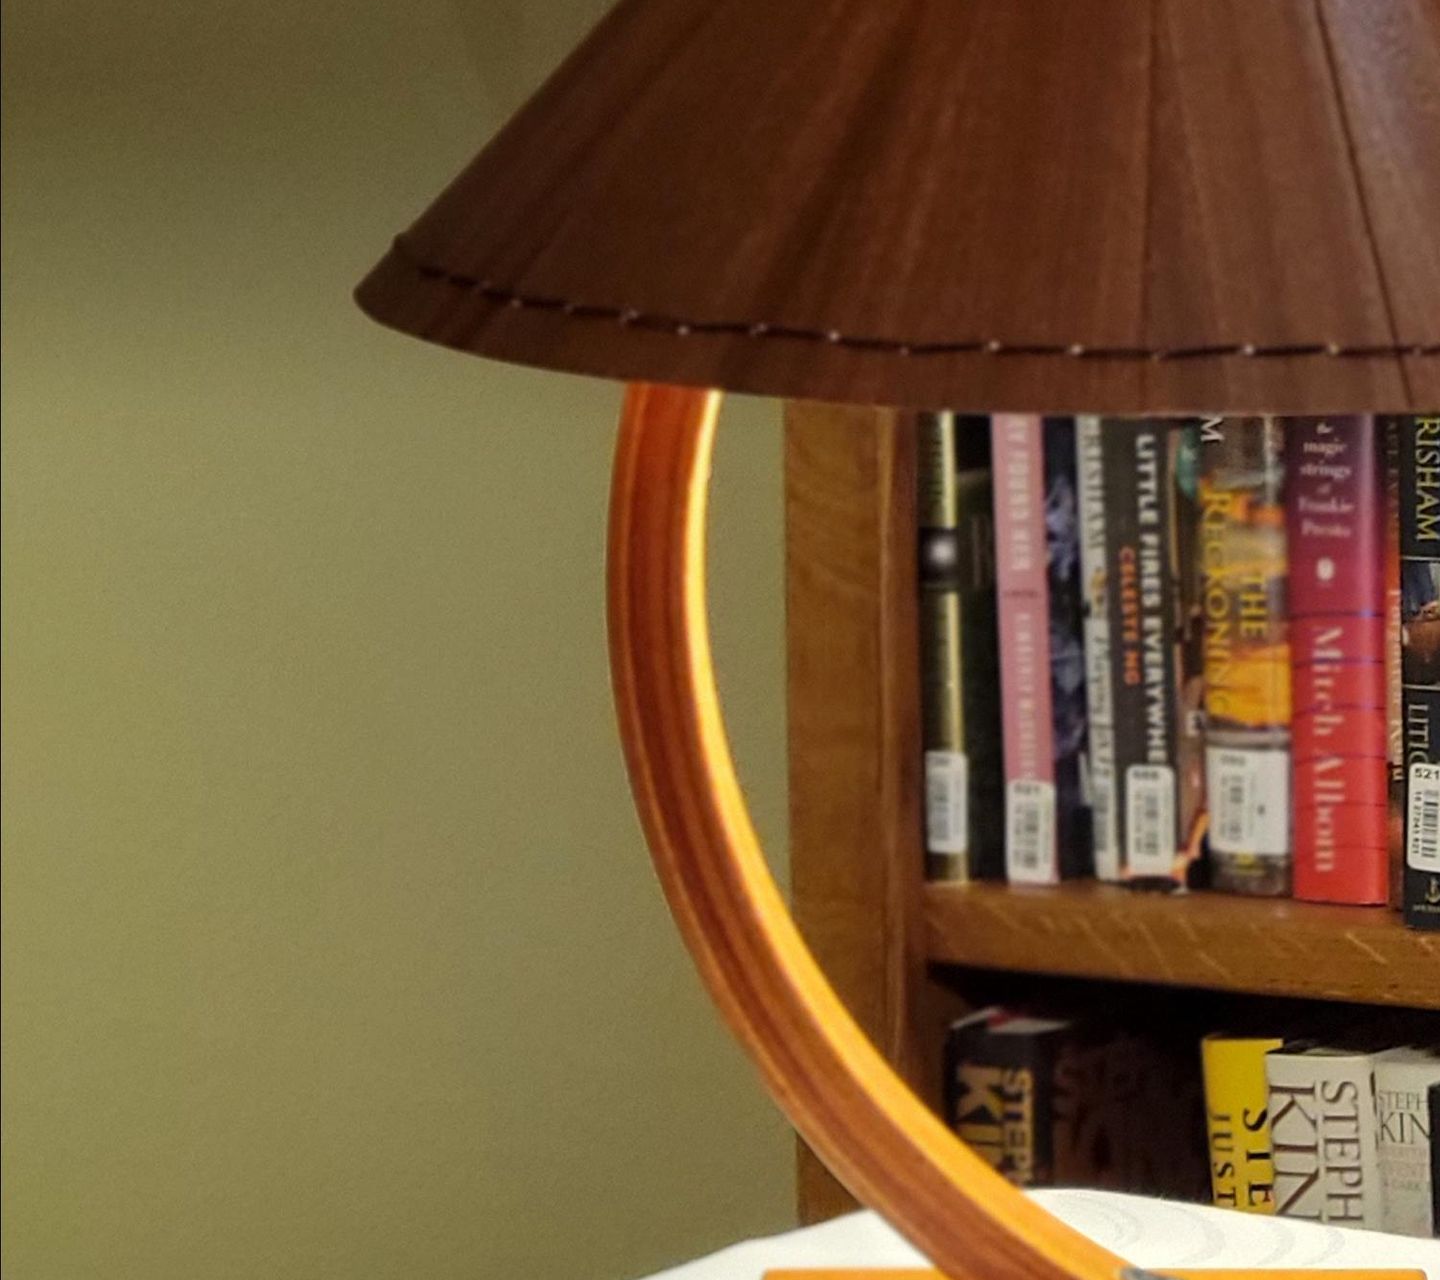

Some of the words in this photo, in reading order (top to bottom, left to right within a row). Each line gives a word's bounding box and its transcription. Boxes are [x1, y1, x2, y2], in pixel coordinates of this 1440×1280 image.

[1135, 433, 1156, 523] LITTLE
[1120, 546, 1139, 646] CELESTE
[1139, 531, 1160, 611] FIRES
[1202, 489, 1236, 718] RECKONING
[1240, 572, 1268, 639] THE
[1312, 625, 1346, 738] Mitch
[1312, 749, 1347, 874] Albom
[1414, 768, 1440, 781] 521
